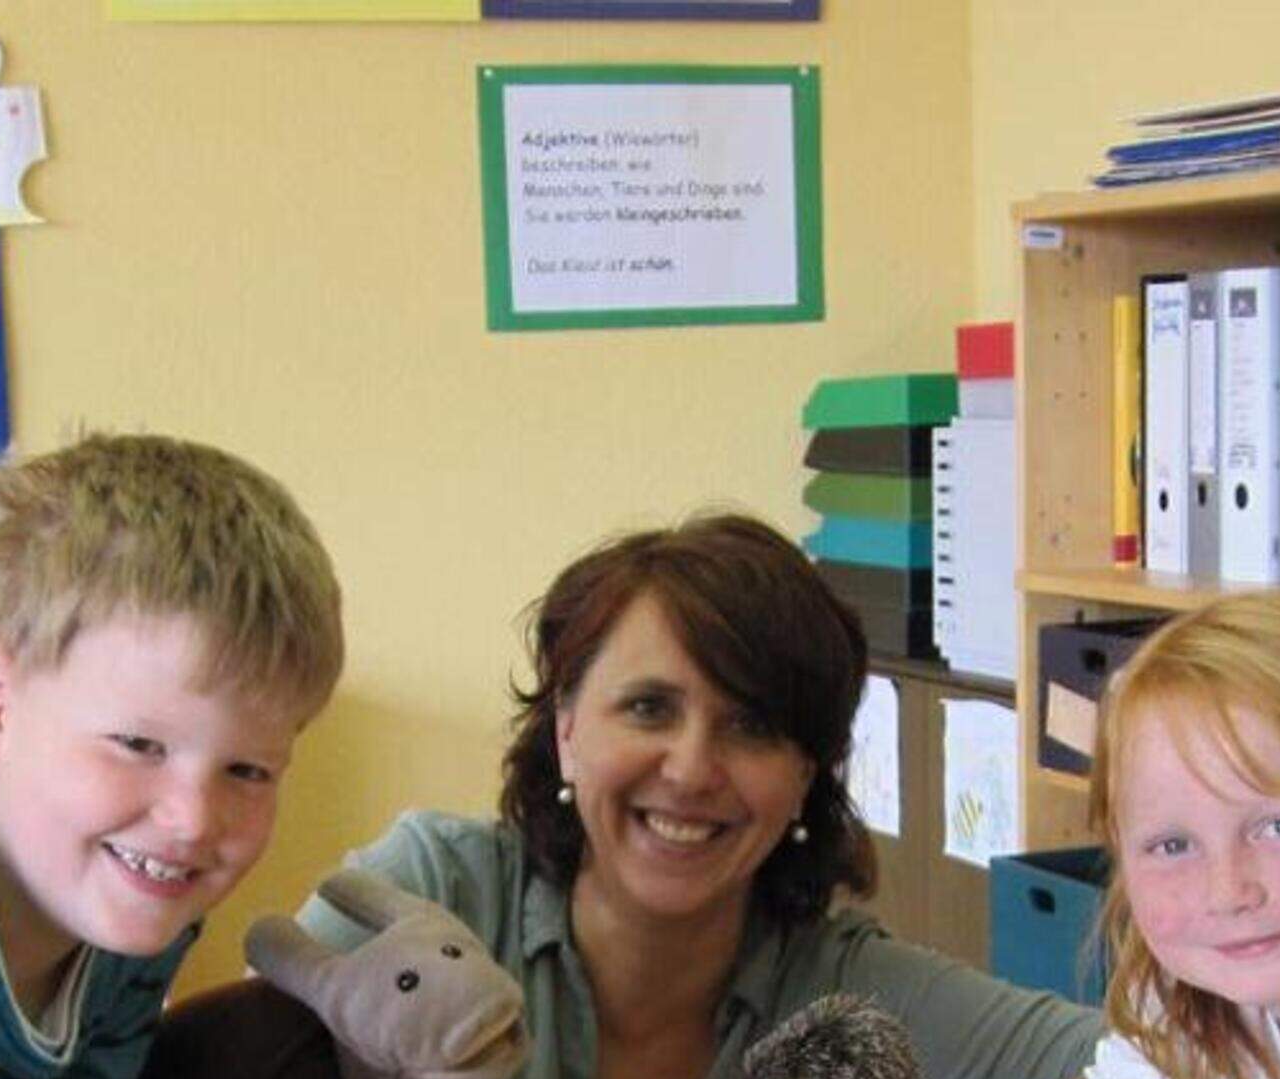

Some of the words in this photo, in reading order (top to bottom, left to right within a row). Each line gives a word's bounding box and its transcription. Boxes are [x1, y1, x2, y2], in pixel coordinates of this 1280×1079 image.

[522, 131, 598, 150] Adjektive
[611, 180, 651, 196] Tiere
[656, 181, 682, 196] und
[688, 181, 728, 200] Dinge
[525, 208, 549, 222] Sie
[554, 206, 611, 222] werden
[527, 258, 557, 274] Das
[606, 257, 624, 272] ist
